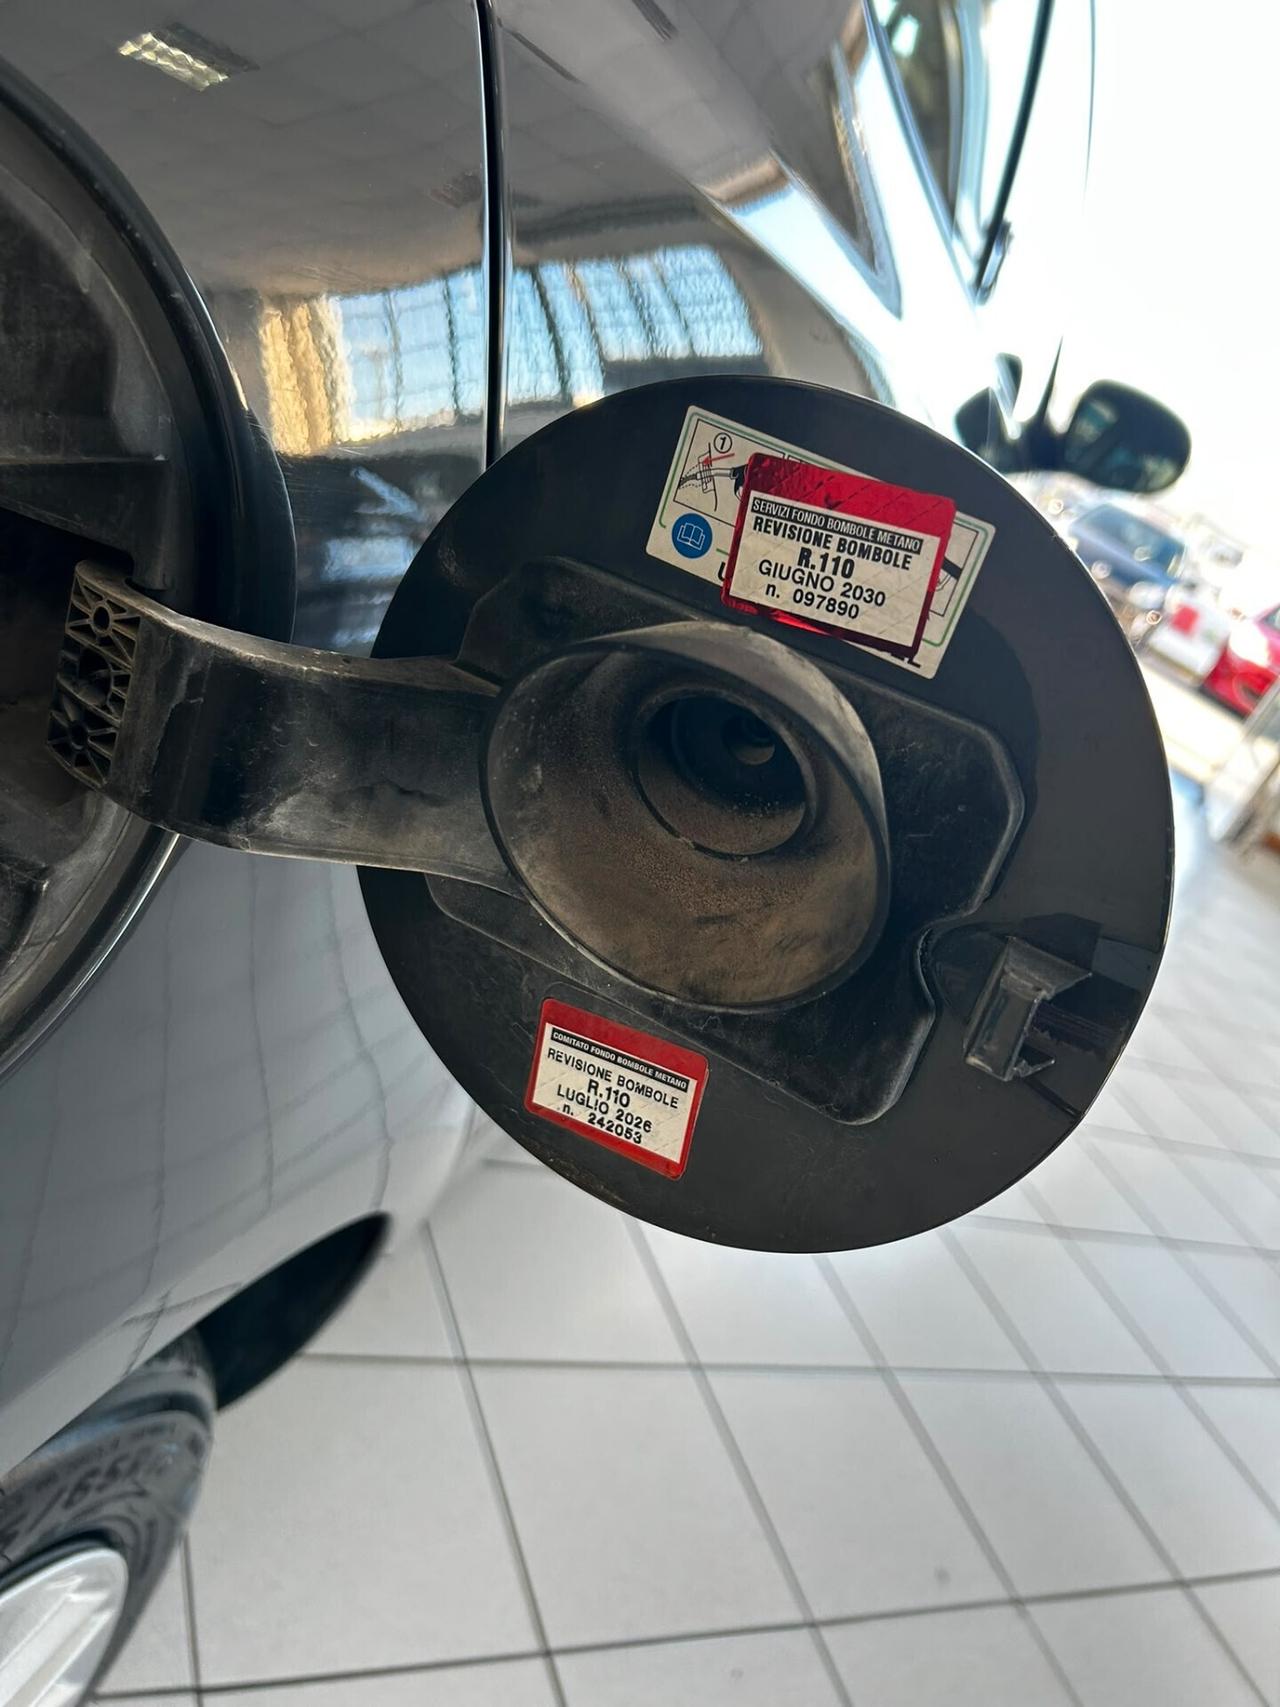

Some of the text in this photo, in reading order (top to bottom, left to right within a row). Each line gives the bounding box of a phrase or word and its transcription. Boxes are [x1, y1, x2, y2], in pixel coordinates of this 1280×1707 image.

[752, 515, 913, 571] REVISIONE BOMBOLE
[753, 499, 921, 551] SERVIZI FONDO BOMBOLE METANO
[758, 559, 835, 592] GIUGNO
[840, 582, 886, 607] 2030
[797, 546, 856, 579] R.110
[765, 583, 860, 619] n. 097890
[547, 1047, 680, 1109] REVISIONE BOMBOLE
[552, 1031, 688, 1089] COMITATO FONDO BOMBOLE METANO
[556, 1084, 653, 1133] LUGLIO 2026
[587, 1079, 631, 1108] R.110
[562, 1103, 643, 1145] n. 242053
